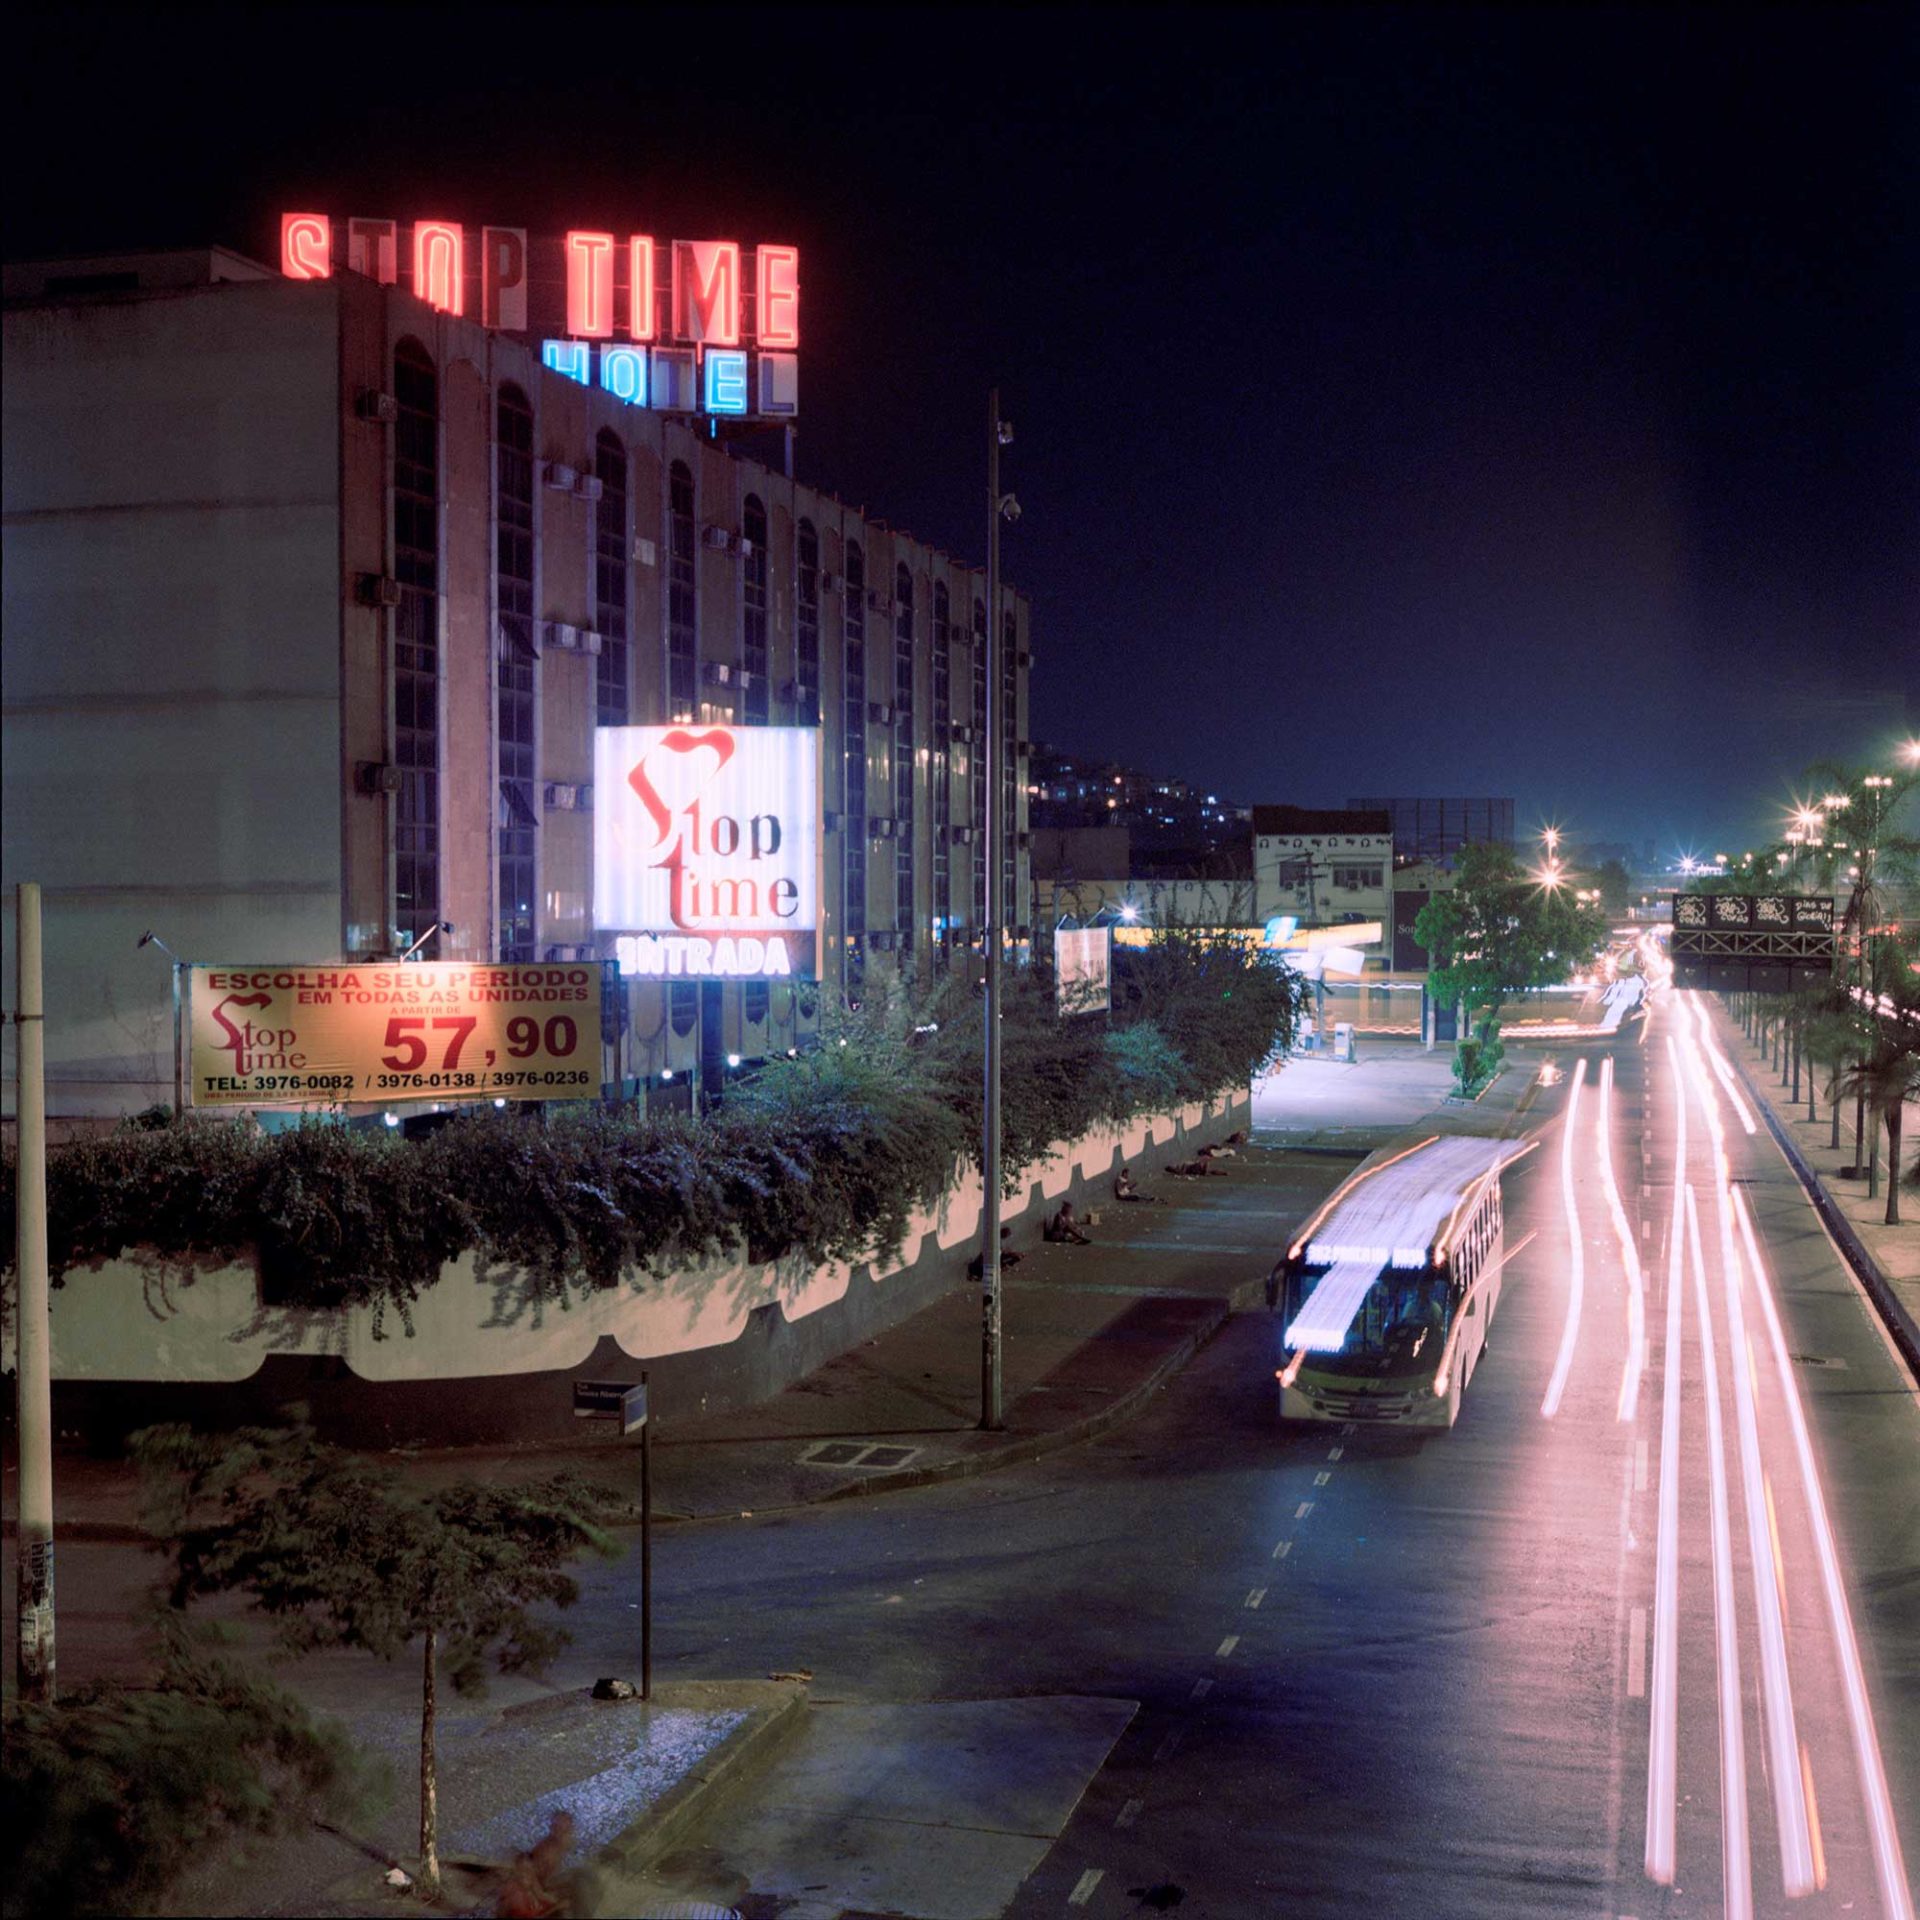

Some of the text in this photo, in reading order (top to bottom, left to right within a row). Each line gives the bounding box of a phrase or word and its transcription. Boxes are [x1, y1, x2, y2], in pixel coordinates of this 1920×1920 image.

[282, 213, 798, 348] STOP TIME
[543, 340, 798, 416] HOTEL
[627, 729, 782, 861] Stop
[648, 833, 799, 930] time
[208, 968, 589, 990] ESCOLHA SEU PERÍODO
[616, 936, 791, 976] ENTRADA
[298, 988, 589, 1005] EM TODAS AS UNIDADES
[390, 1006, 461, 1015] A PARTIR DE
[209, 992, 297, 1053] Stop
[381, 1015, 578, 1072] 57,90
[234, 1034, 307, 1076] time
[204, 1077, 247, 1091] TEL:
[254, 1075, 354, 1090] 3976-0082
[377, 1073, 476, 1088] 3976-0138
[492, 1071, 589, 1085] 3976-0236
